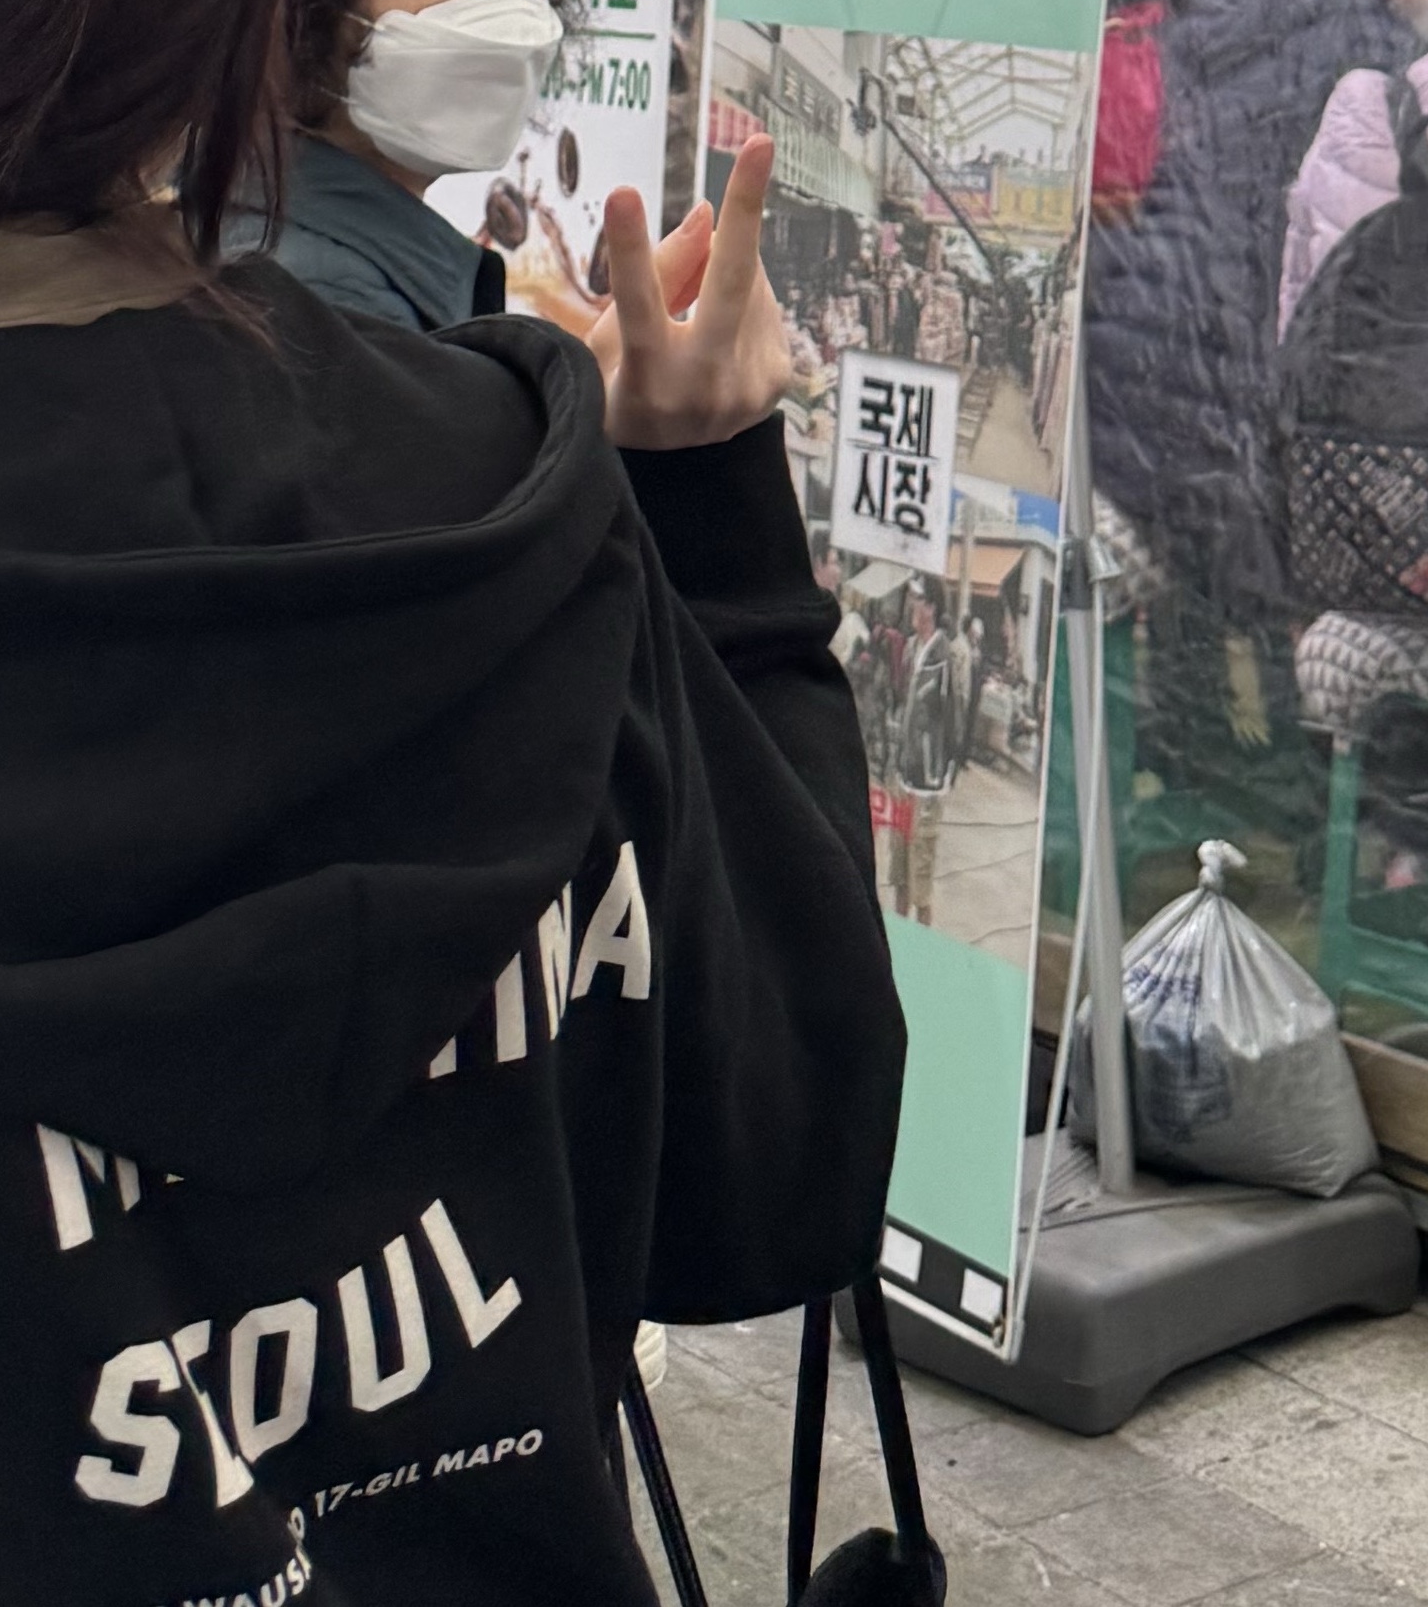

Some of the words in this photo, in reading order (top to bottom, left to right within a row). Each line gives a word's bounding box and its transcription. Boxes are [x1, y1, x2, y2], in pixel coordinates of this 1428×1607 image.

[859, 376, 933, 457] 국제
[854, 451, 931, 540] 시장
[314, 1461, 421, 1518] 17-GIL
[432, 1428, 543, 1478] MAPO
